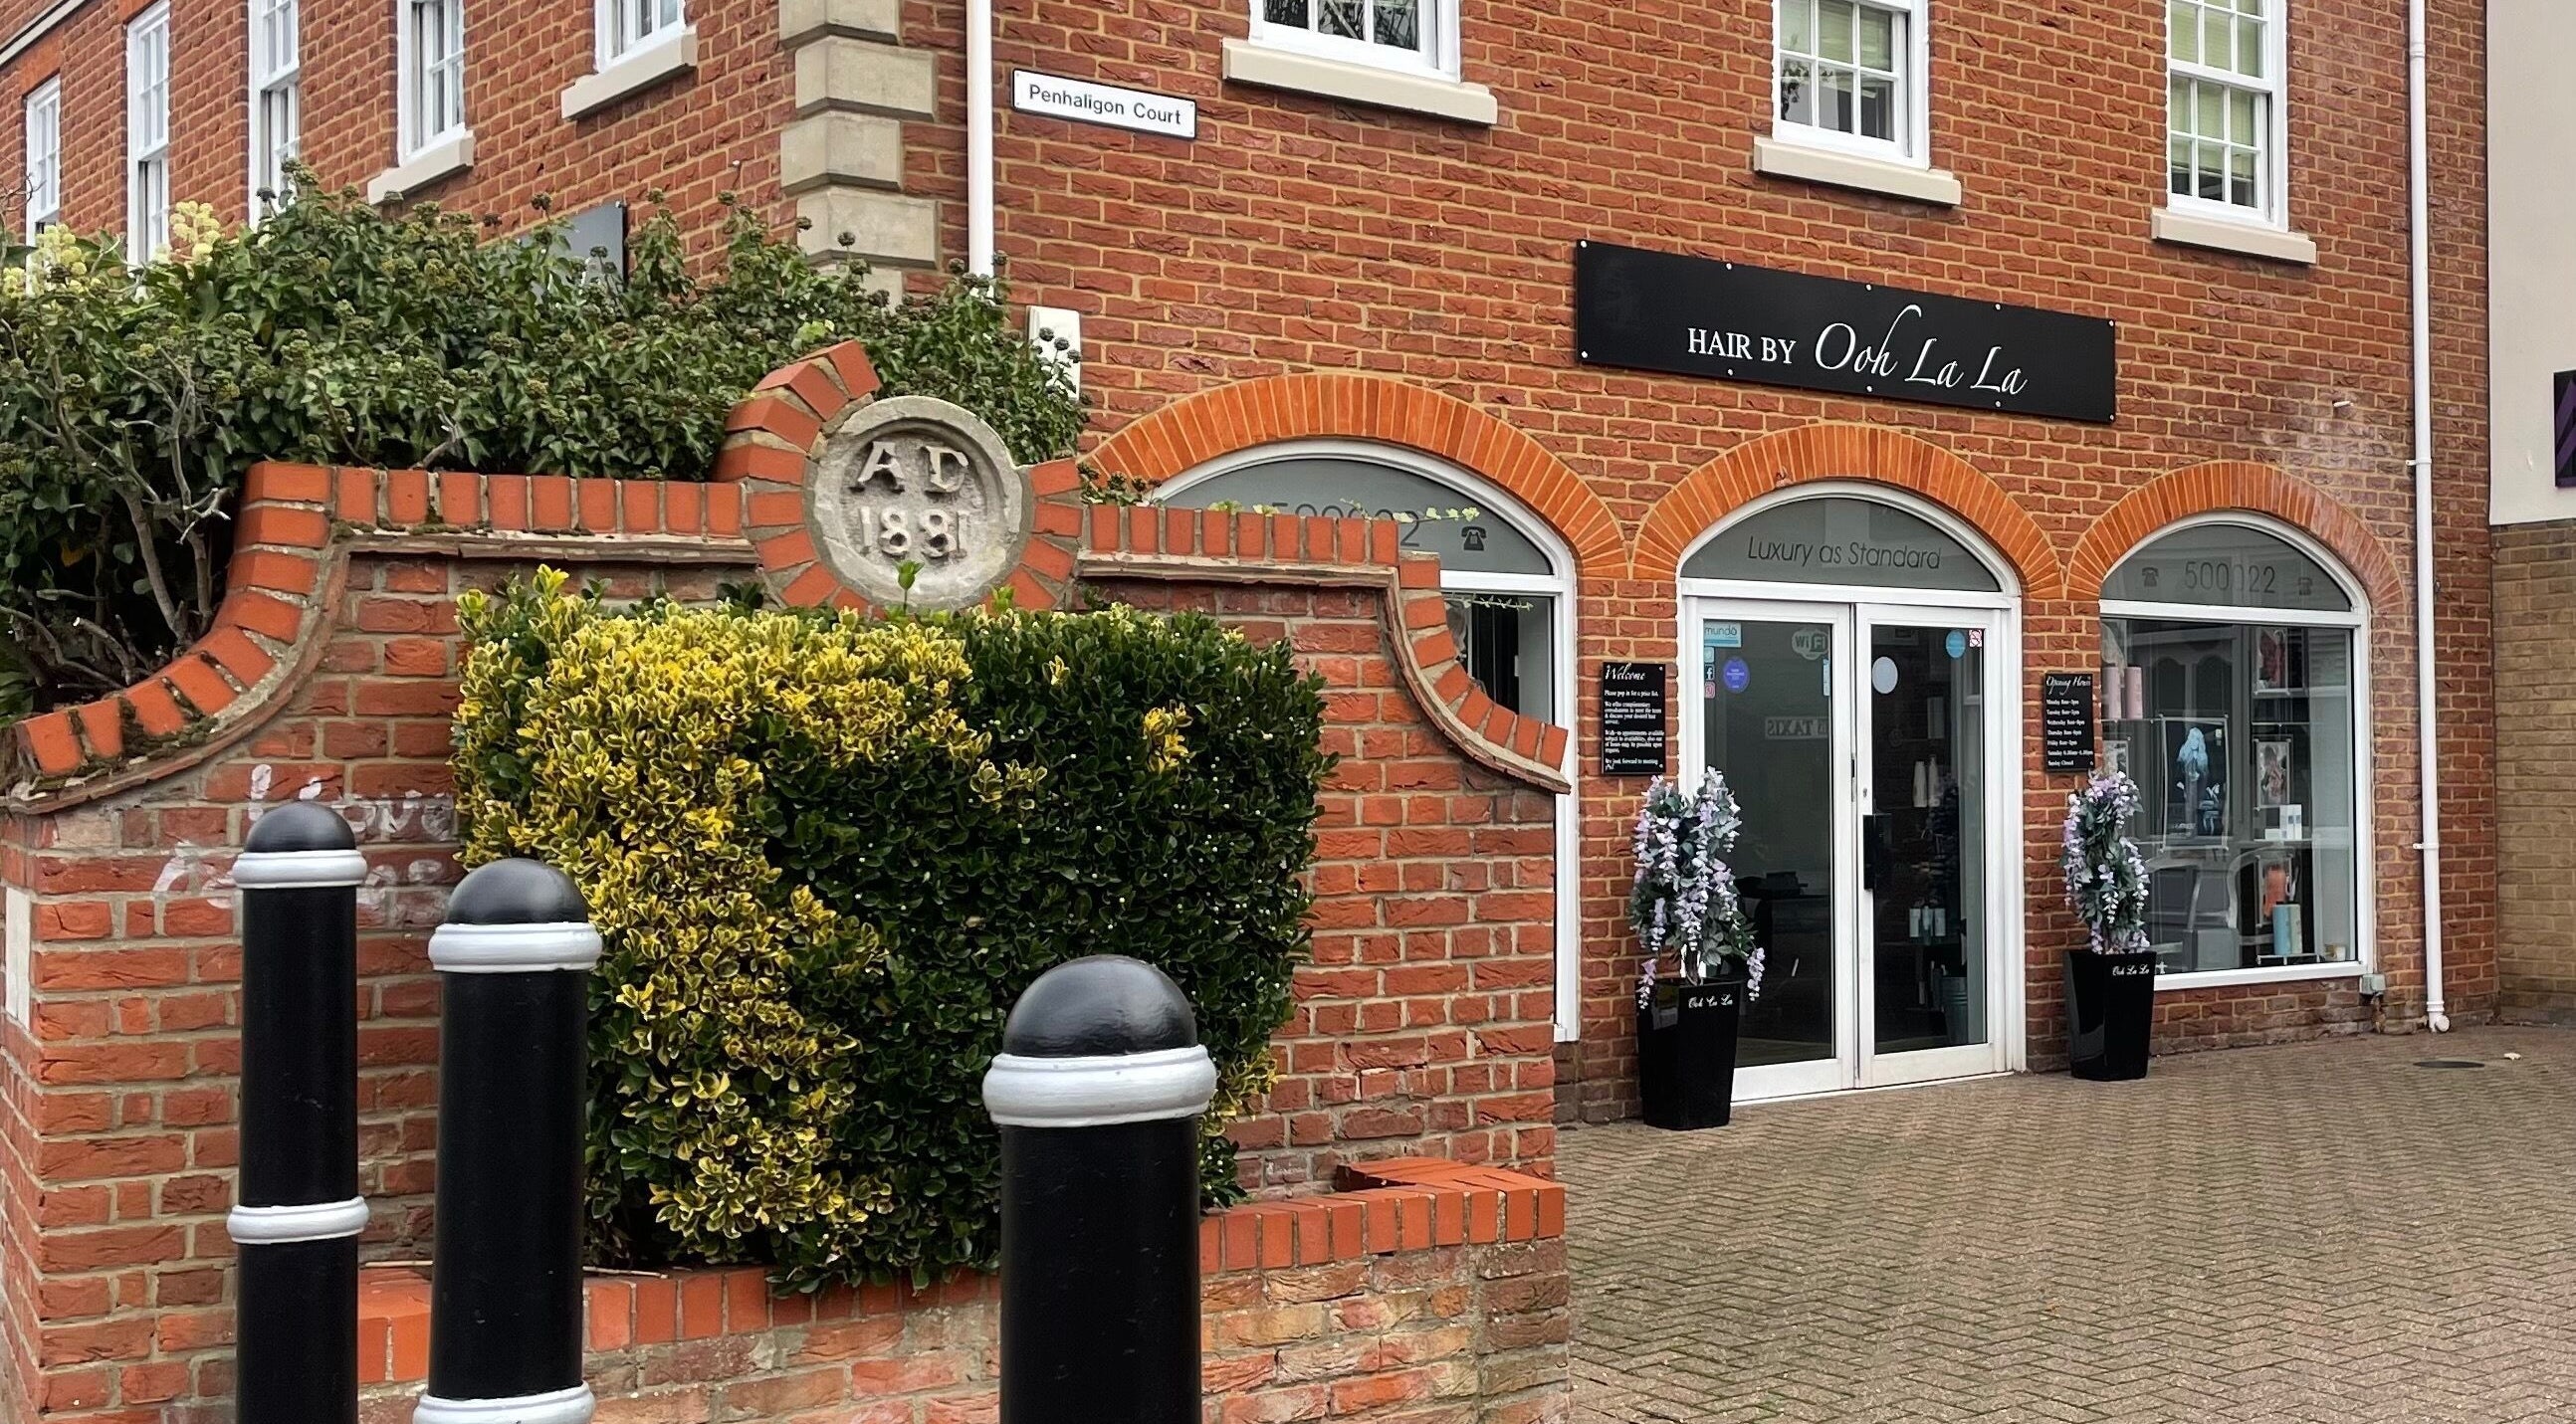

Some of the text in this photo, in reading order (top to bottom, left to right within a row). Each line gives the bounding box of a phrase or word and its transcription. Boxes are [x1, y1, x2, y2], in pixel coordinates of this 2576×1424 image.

[1028, 84, 1181, 125] Penhaligon Court
[1687, 304, 2029, 396] HAIR BY Ooh La La
[859, 505, 971, 558] 1881
[1747, 534, 1942, 570] Luxury as Standard
